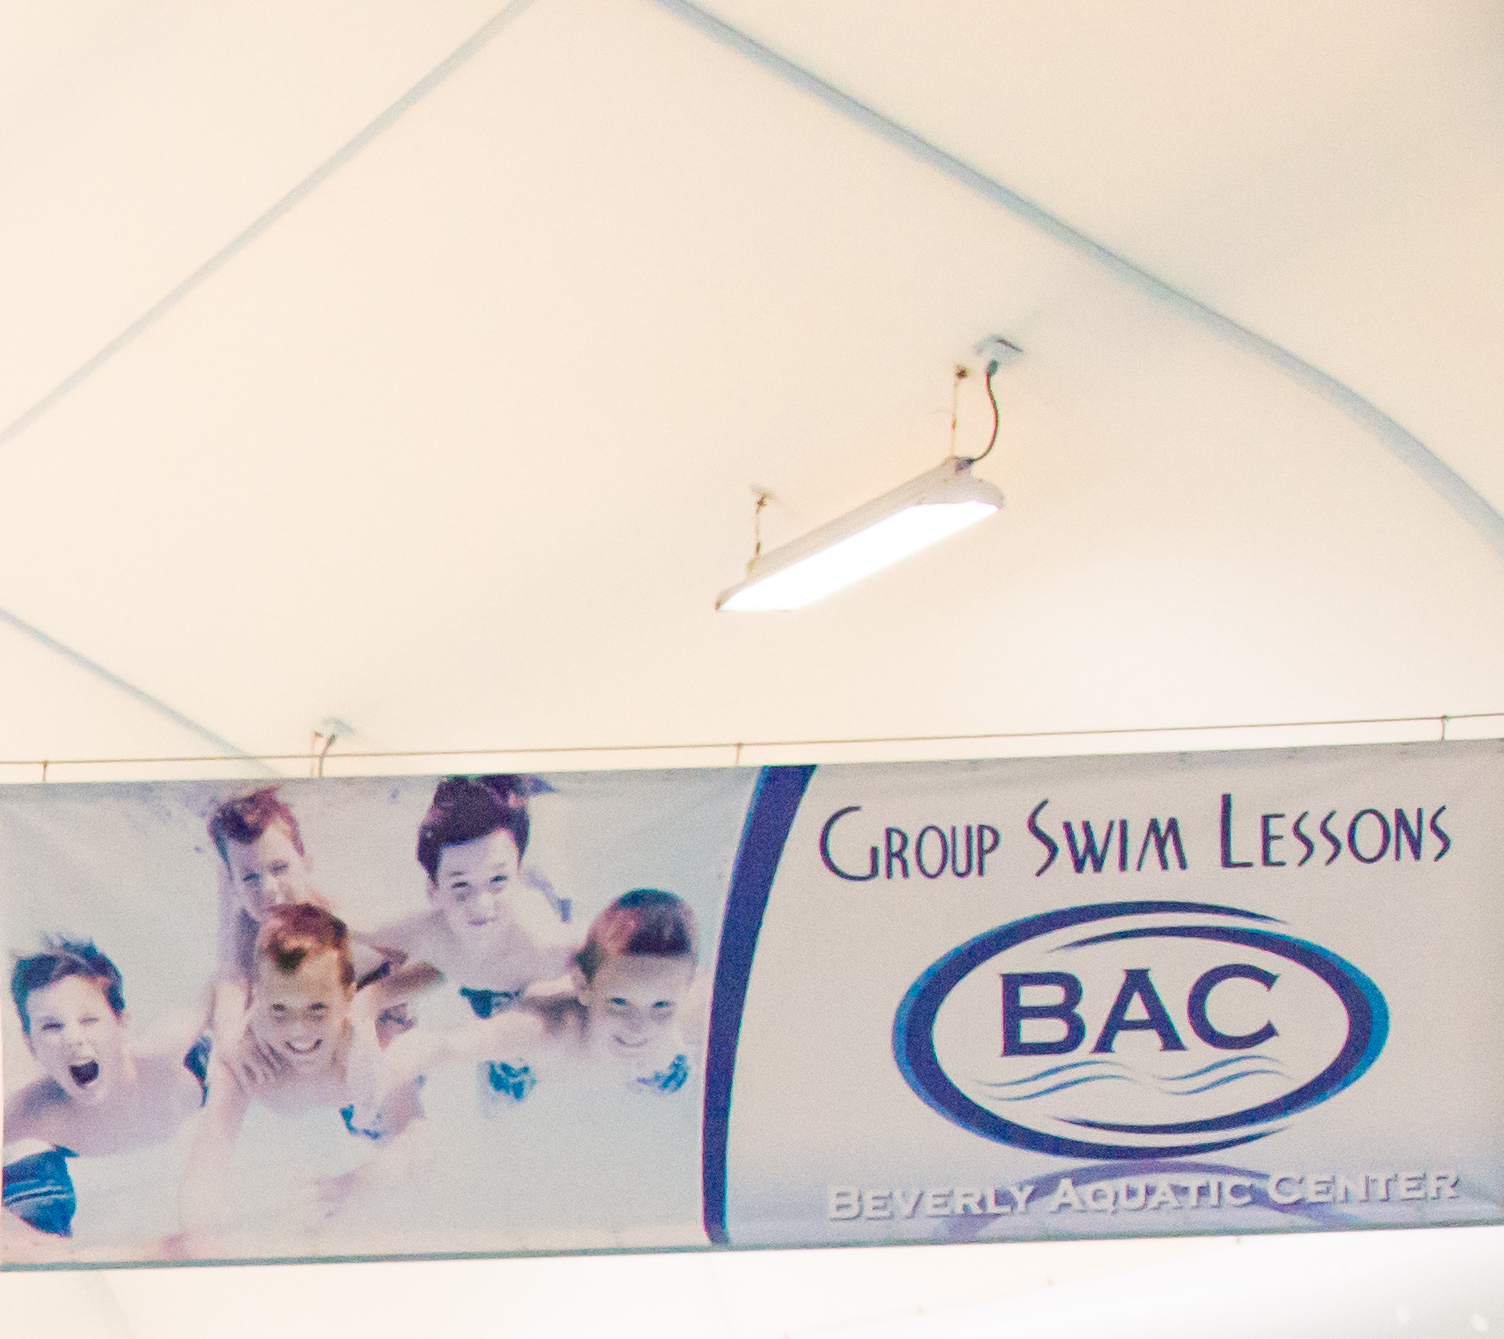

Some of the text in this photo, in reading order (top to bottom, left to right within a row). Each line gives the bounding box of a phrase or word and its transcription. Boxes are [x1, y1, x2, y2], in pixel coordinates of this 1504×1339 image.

[820, 793, 1453, 881] GROUP SWIM LESSONS
[999, 963, 1280, 1057] BAC
[828, 1169, 1461, 1222] BEVERLY AQUATIC CENTER
